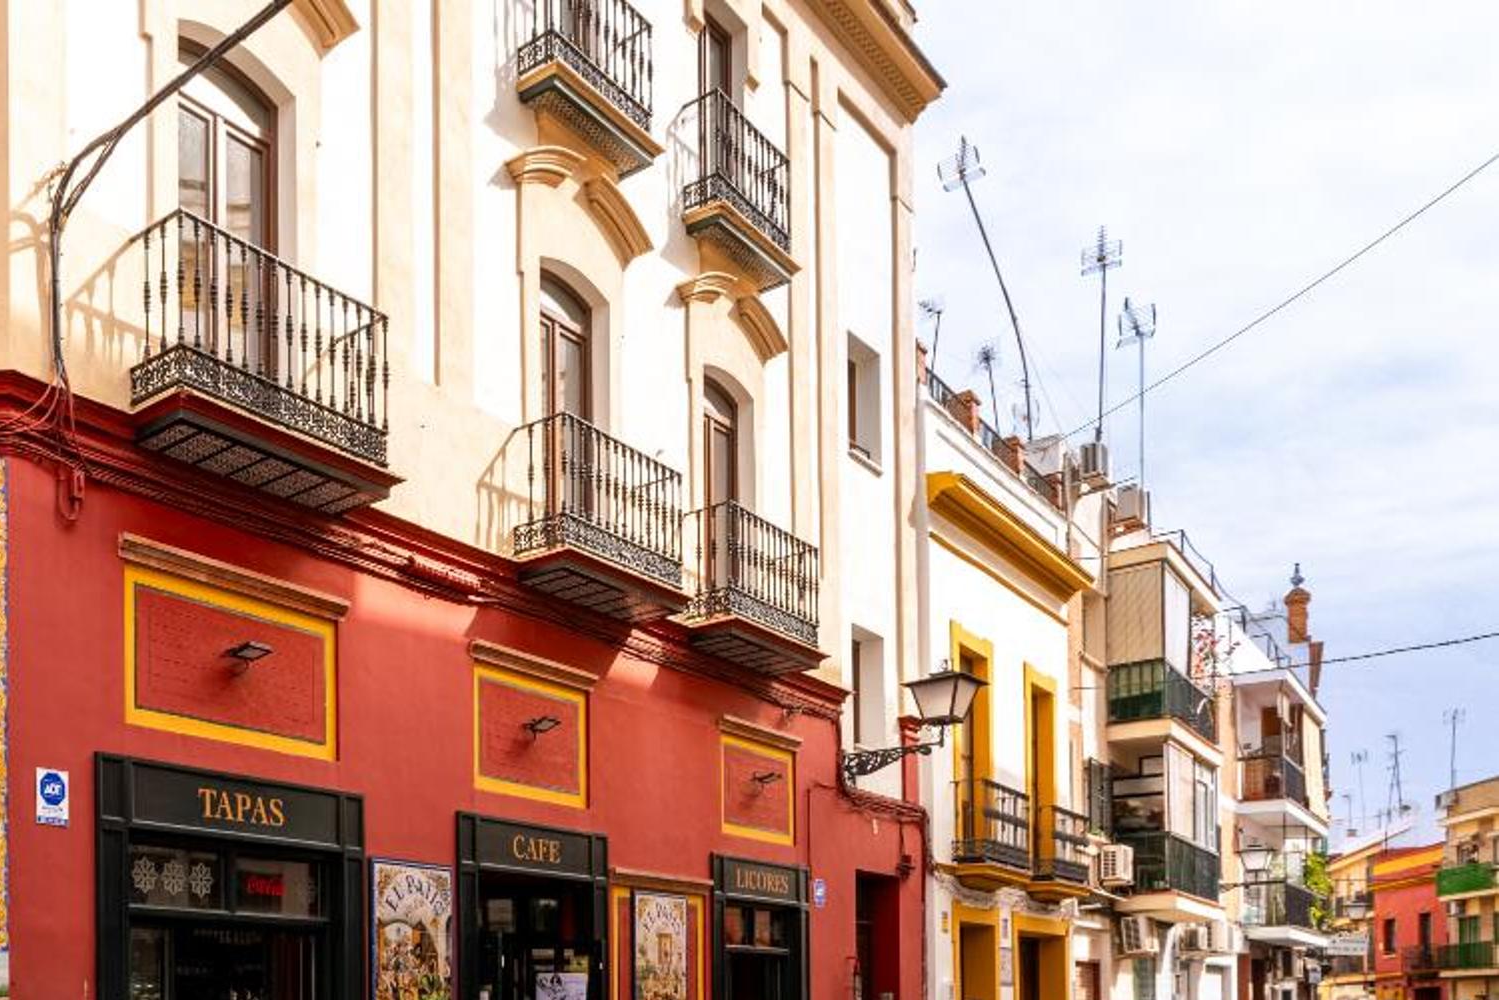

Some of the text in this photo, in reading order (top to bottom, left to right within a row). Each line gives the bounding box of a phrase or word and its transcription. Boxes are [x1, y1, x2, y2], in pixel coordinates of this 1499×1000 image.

[197, 787, 286, 827] TAPAS
[513, 833, 562, 864] CAFE
[736, 867, 789, 894] LICORES
